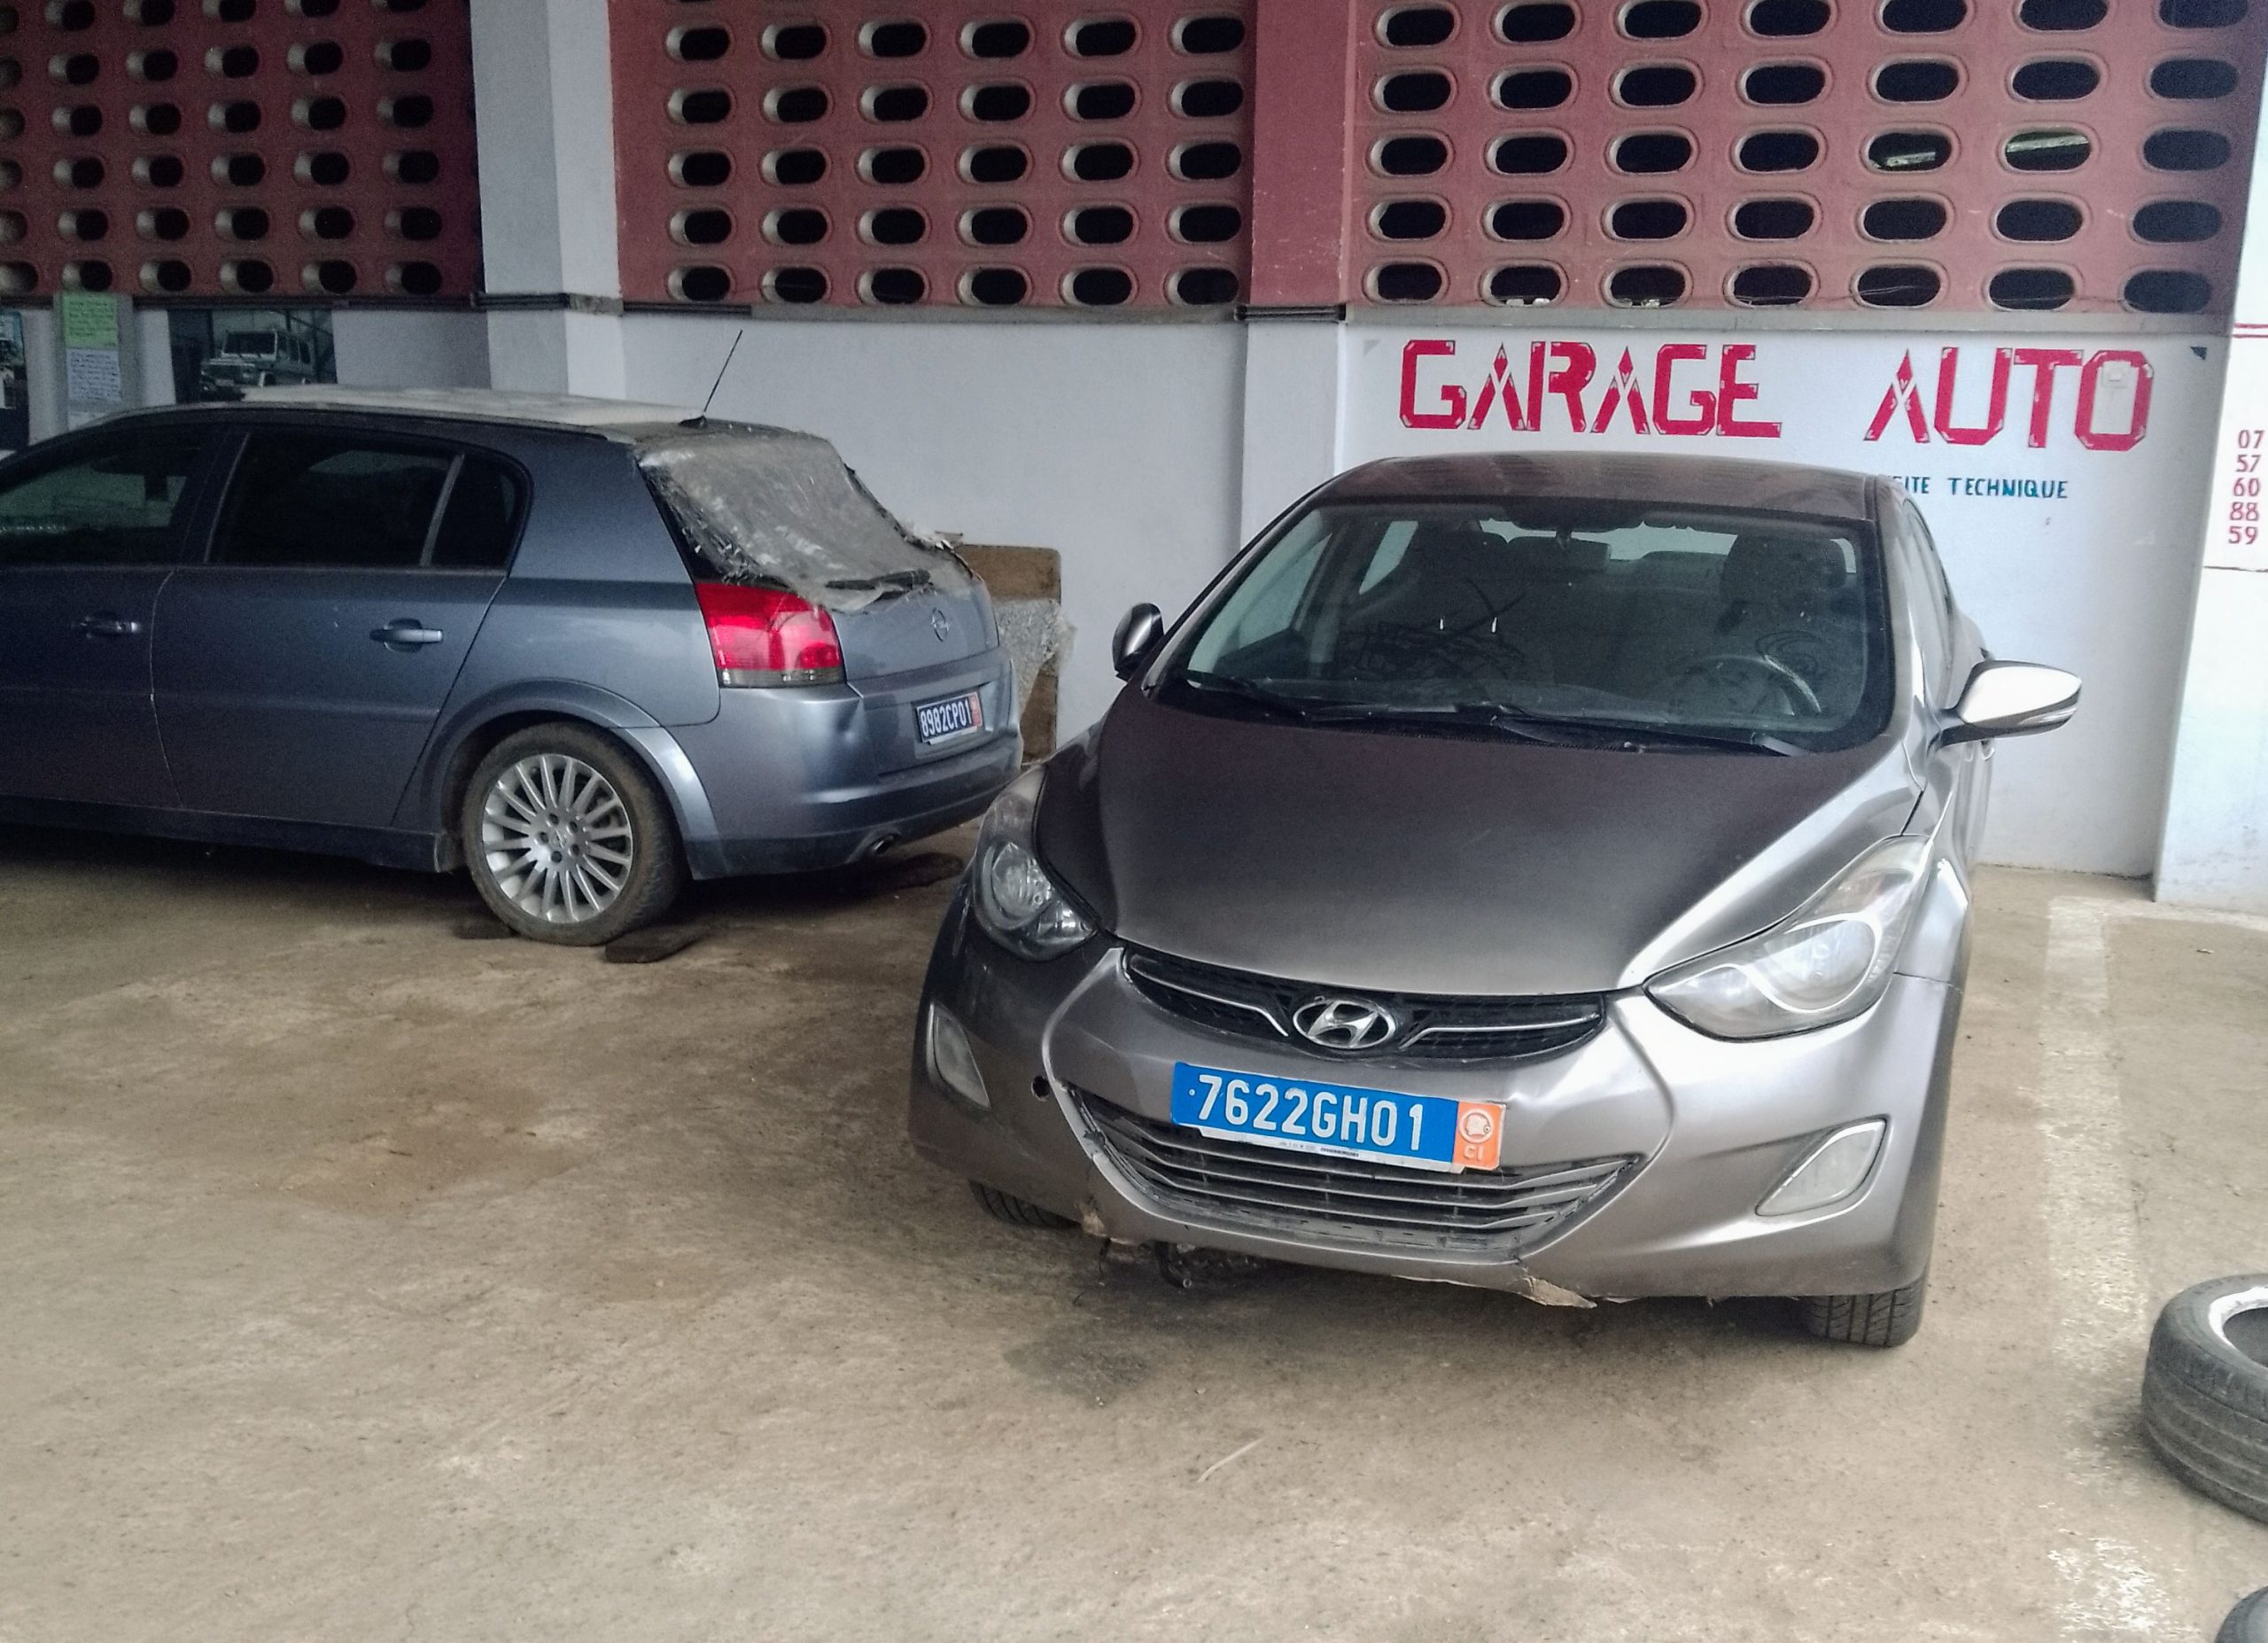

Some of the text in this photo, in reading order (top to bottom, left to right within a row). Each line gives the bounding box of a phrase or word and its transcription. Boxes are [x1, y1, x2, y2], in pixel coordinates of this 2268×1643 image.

[1399, 339, 2155, 452] GARAGE AUTO
[2238, 429, 2265, 449] 07
[2235, 454, 2262, 473] 57
[1892, 476, 2069, 499] ITE TECHNIQUE
[2233, 478, 2261, 497] 60
[2229, 501, 2260, 521] 88
[2228, 526, 2258, 545] 59
[920, 698, 972, 737] 8982CP01
[1198, 1073, 1424, 1151] 7622GH01
[1463, 1143, 1484, 1163] CI
